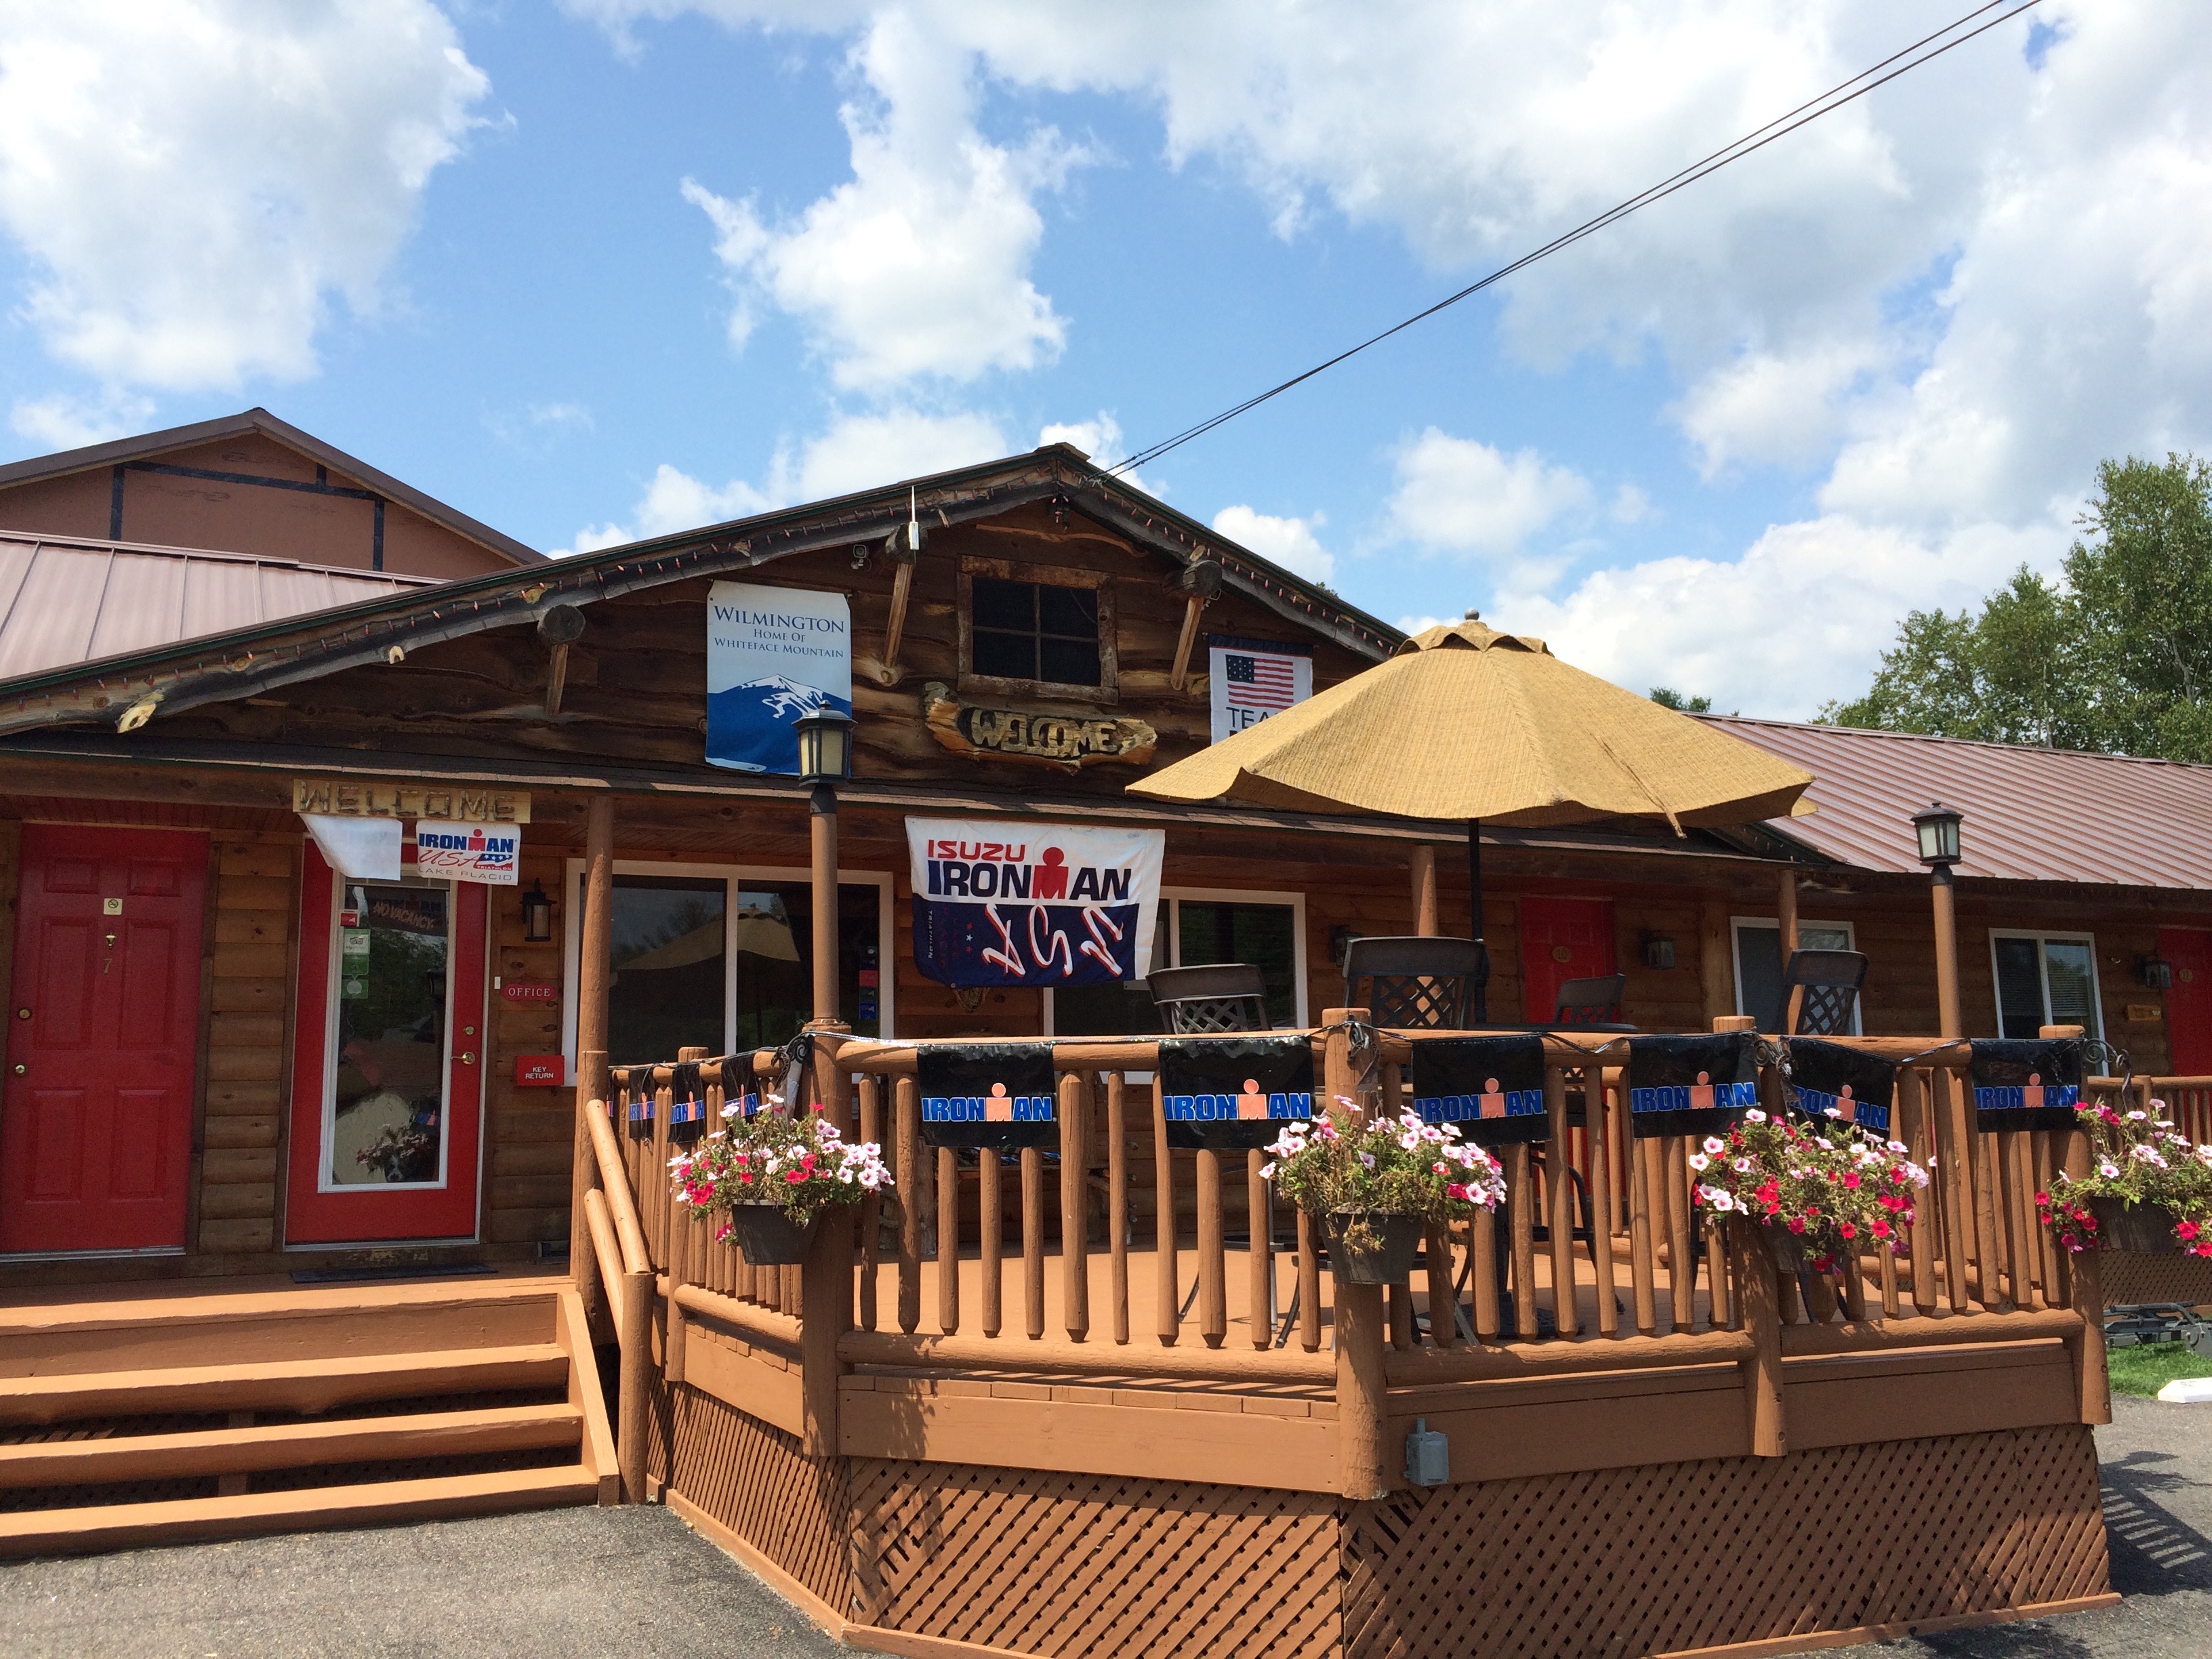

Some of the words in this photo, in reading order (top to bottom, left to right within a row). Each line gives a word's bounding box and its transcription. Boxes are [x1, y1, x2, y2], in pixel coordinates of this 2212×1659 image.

[714, 605, 844, 633] WILMINGTON
[754, 628, 788, 640] HOME
[714, 637, 779, 653] WHITEFACE
[783, 644, 844, 657] MOUNTAIN
[1226, 707, 1279, 729] TEA
[970, 709, 1119, 758] WELCOME
[300, 781, 516, 822] WELCOME
[419, 829, 514, 853] IRONMAN
[928, 839, 1026, 863] ISUZU
[419, 849, 483, 869] USA
[418, 866, 453, 876] LAKE
[461, 871, 512, 881] PLACID
[928, 846, 1132, 901] IRONMAN
[373, 901, 390, 916] NO
[103, 958, 113, 974] 7
[508, 987, 550, 997] OFFICE
[922, 1082, 1052, 1122] IRONMAN
[1164, 1078, 1311, 1121] IRONMAN
[1414, 1078, 1544, 1124] IRONMAN
[1631, 1071, 1757, 1113] IRONMAN
[1973, 1073, 2078, 1110] IRONMAN
